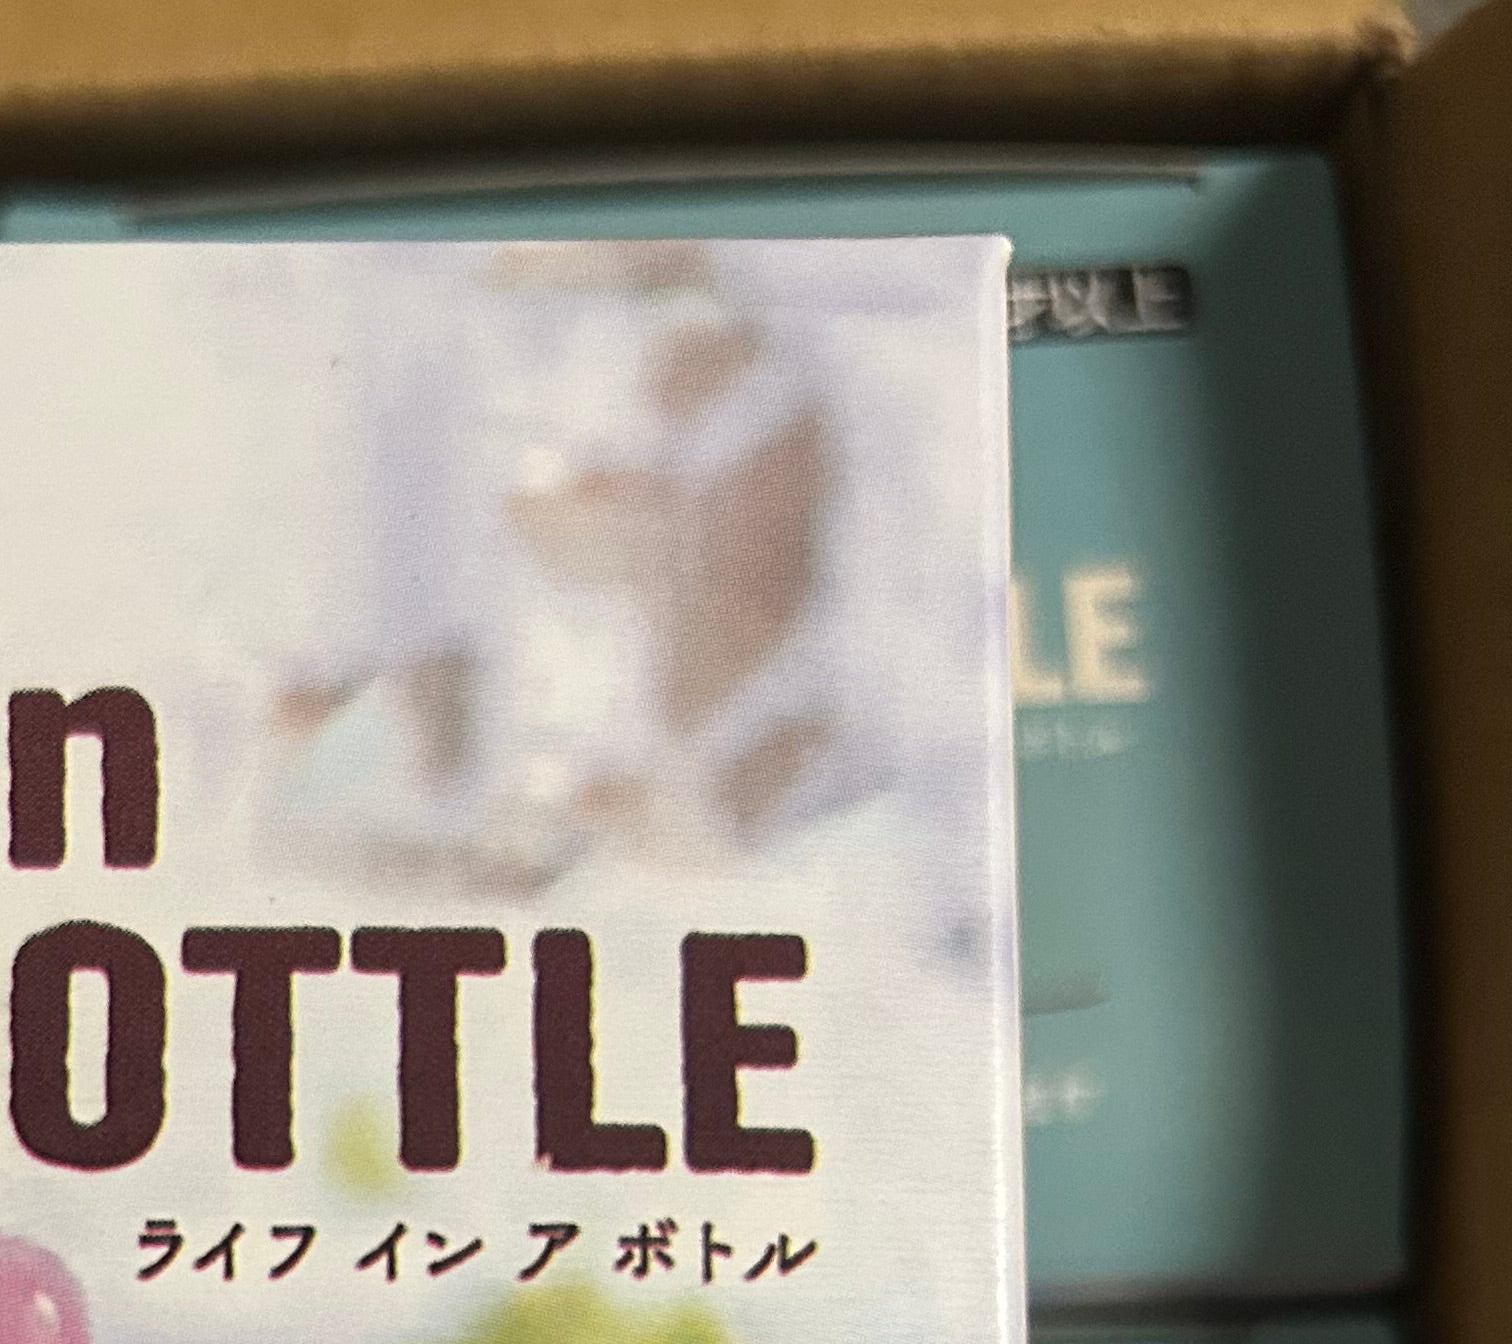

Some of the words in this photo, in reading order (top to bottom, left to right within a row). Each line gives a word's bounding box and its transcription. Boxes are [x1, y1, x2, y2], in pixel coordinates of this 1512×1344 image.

[137, 1219, 318, 1282] ライフ
[354, 1221, 485, 1283] イン
[517, 1222, 582, 1282] ア
[612, 1217, 819, 1285] ボトル
